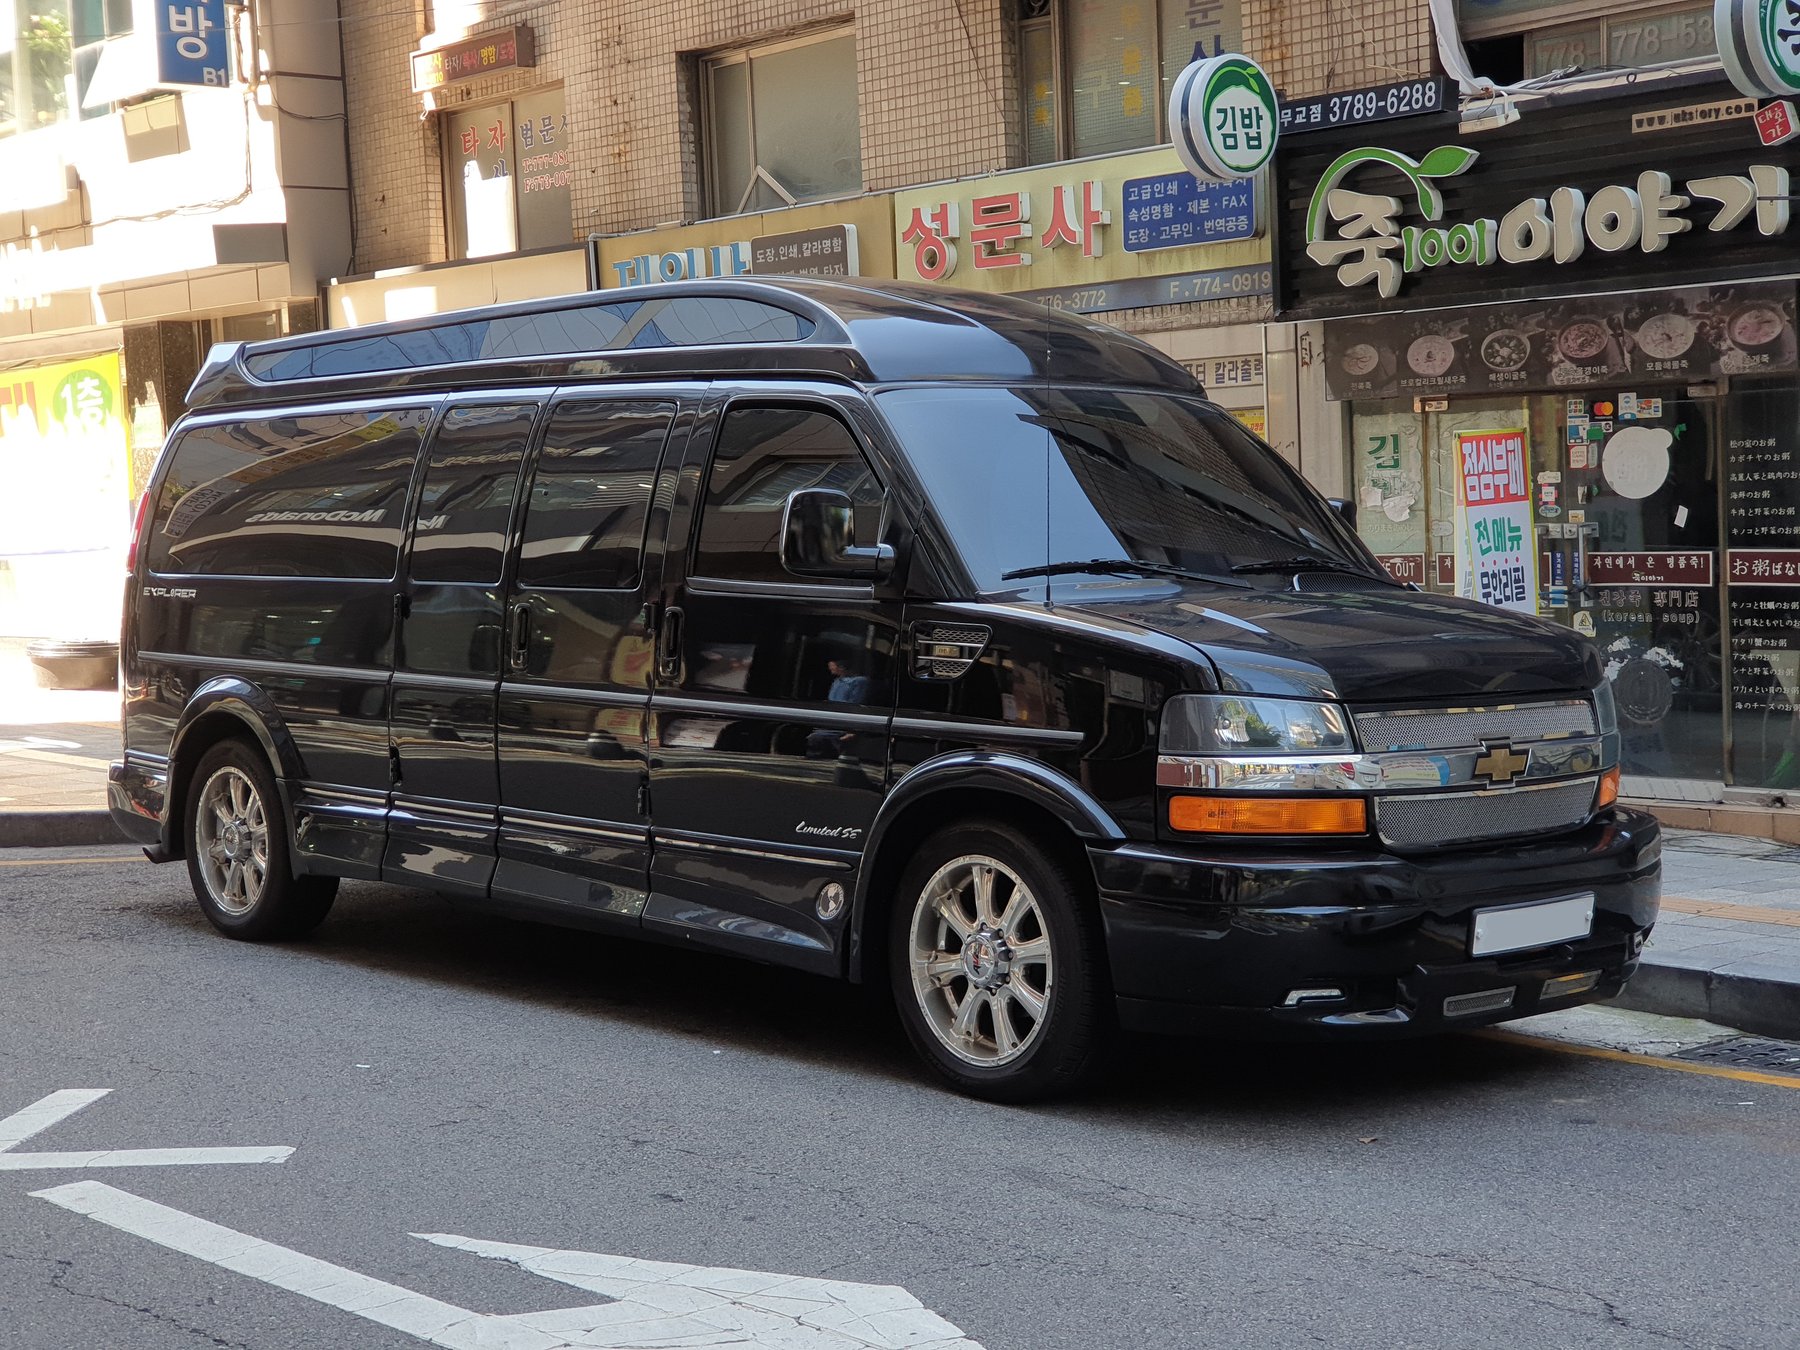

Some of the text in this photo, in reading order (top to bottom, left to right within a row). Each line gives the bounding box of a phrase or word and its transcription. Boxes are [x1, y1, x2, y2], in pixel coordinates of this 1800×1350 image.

[203, 67, 226, 87] B1
[1280, 81, 1436, 127] 무교점 3789-6288
[461, 120, 507, 158] 타자
[1216, 106, 1264, 150] 김밥
[1128, 181, 1178, 201] 고급인쇄
[1129, 194, 1248, 223] 속성명함 제본 FAX
[902, 180, 1112, 281] 성문사
[1128, 215, 1249, 244] 도장 고무인 번역공증
[1215, 358, 1263, 384] 칼라출력
[1367, 434, 1400, 469] 김
[1462, 437, 1525, 501] 점심부페
[1474, 517, 1523, 556] 전메뉴
[1395, 561, 1415, 577] OUT
[1593, 556, 1704, 569] 자연에서 온 명품죽!
[1480, 565, 1526, 606] 무한리필
[795, 820, 862, 839] Limited SE
